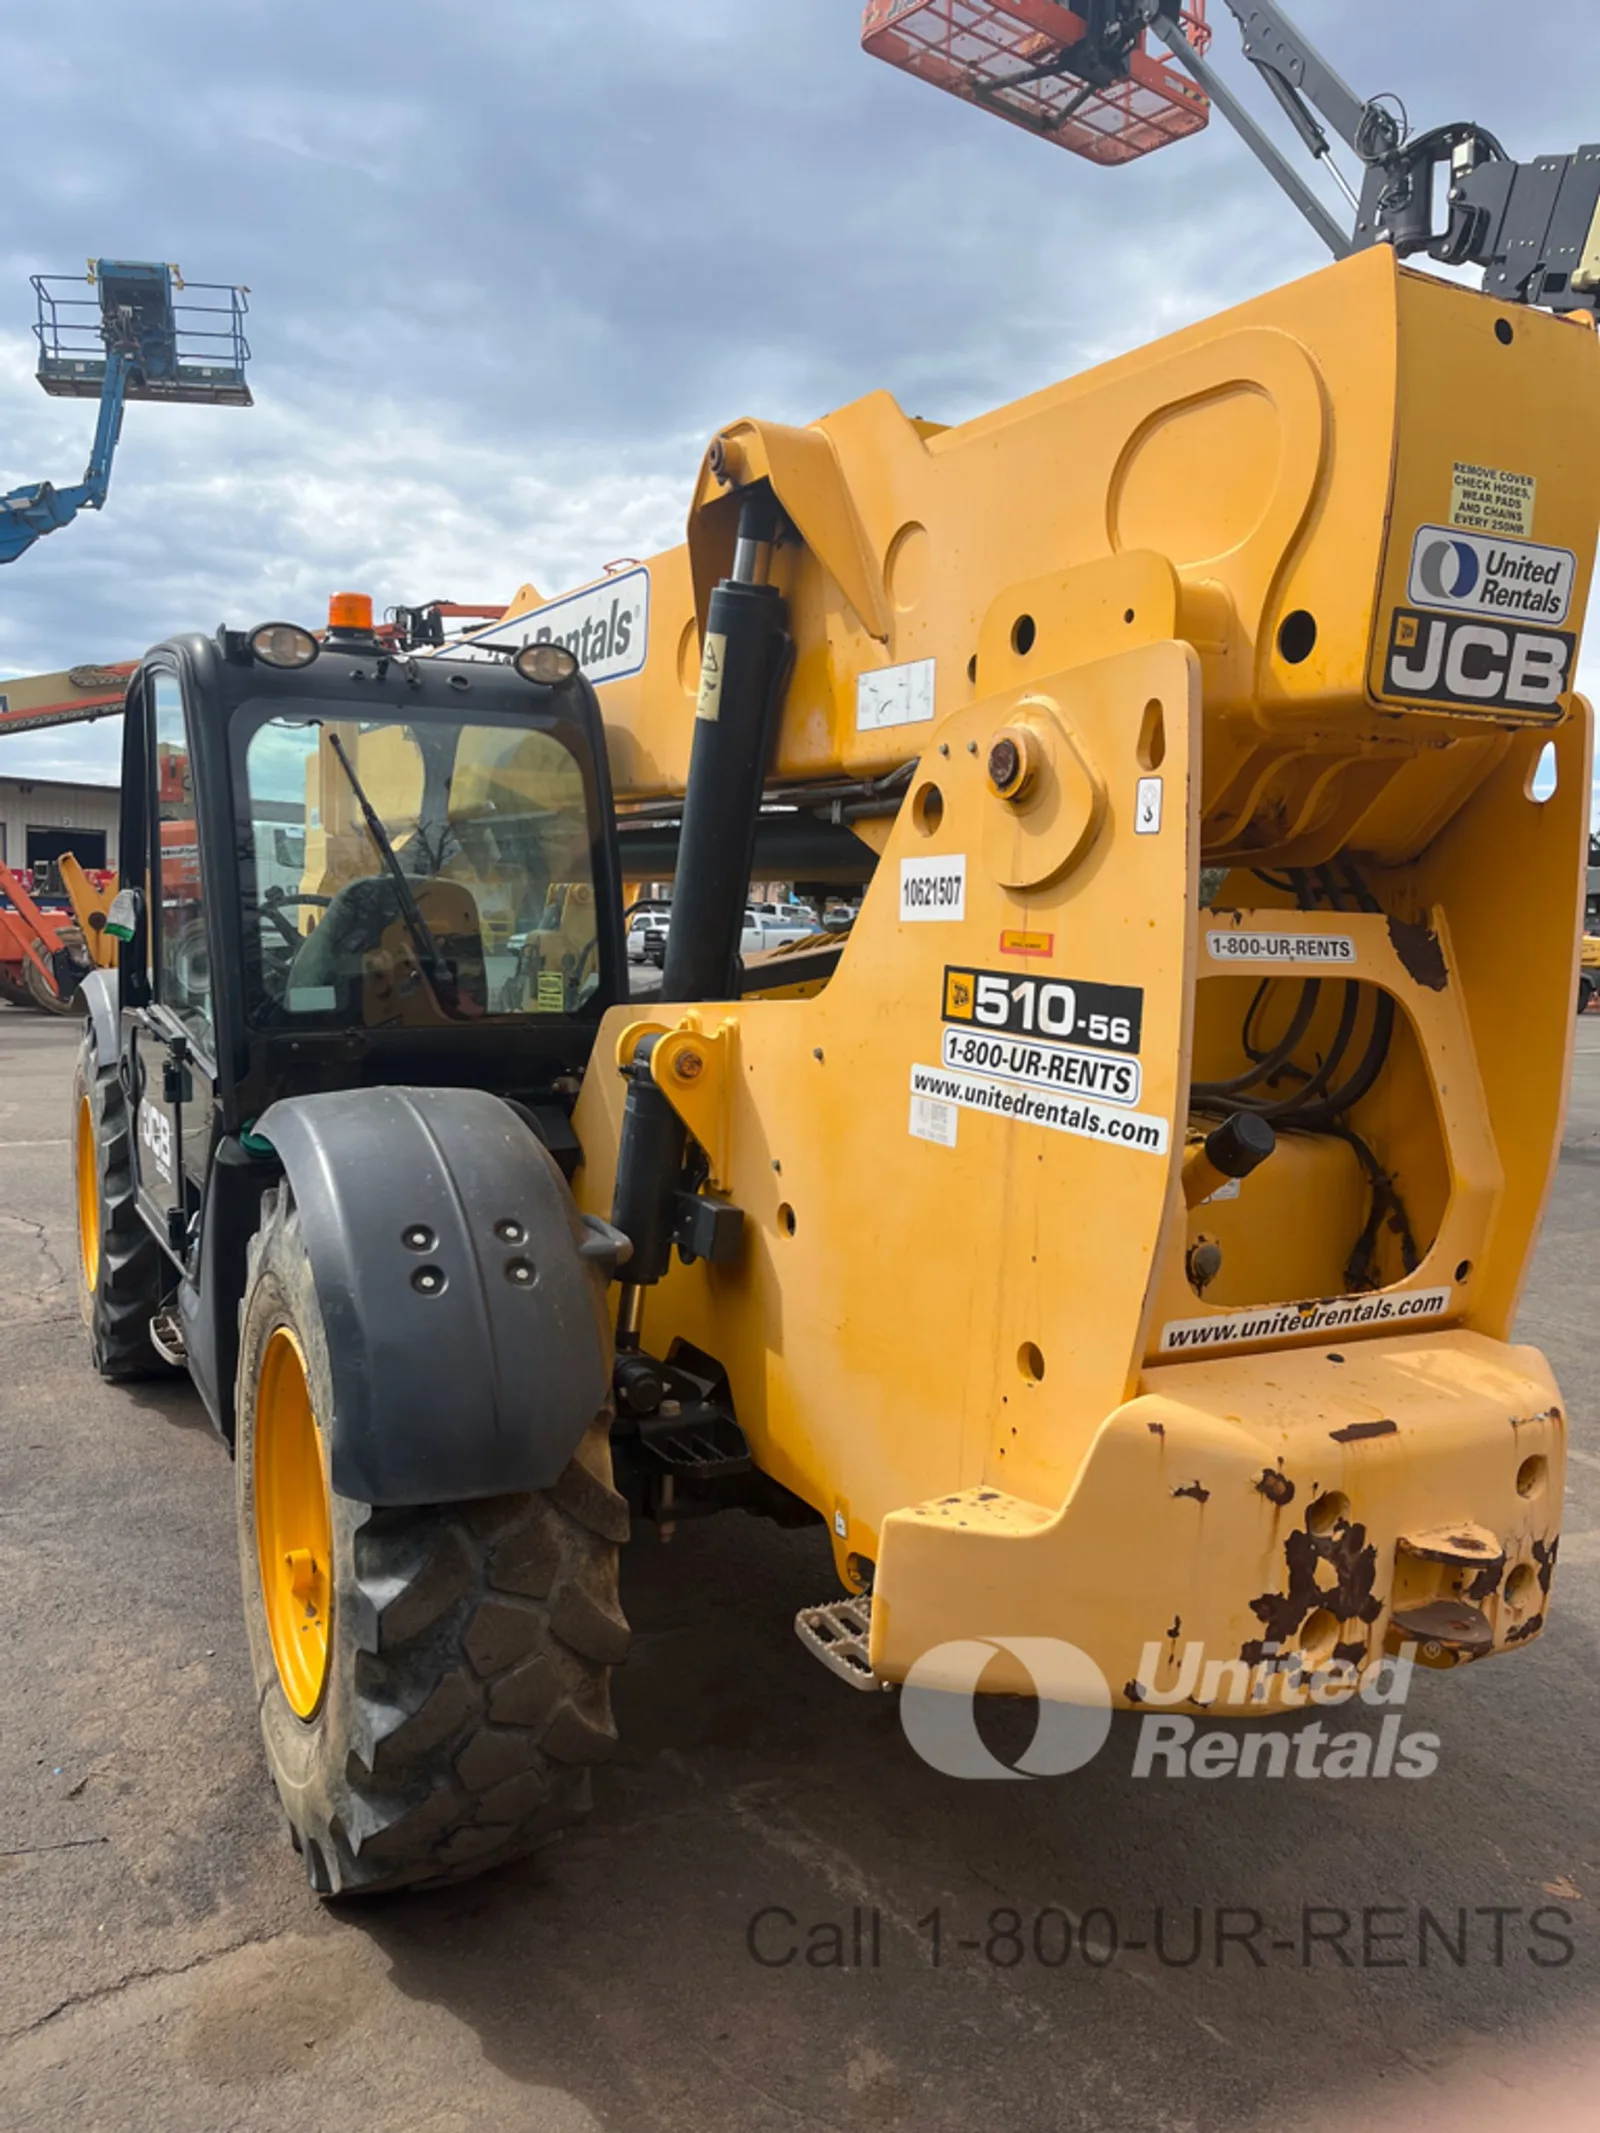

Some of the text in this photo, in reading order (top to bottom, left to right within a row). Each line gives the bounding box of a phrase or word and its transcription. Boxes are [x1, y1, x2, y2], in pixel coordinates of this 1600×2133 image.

[1454, 462, 1533, 486] REMOVE COVER
[1454, 475, 1530, 500] CHECK HOSES,
[1458, 502, 1521, 521] AND CHAINS
[1463, 489, 1521, 509] WEAR PADS
[1454, 513, 1488, 527] EVERY
[1486, 550, 1561, 585] United
[1479, 579, 1561, 614] Rentals
[1390, 620, 1568, 704] JCB
[903, 876, 962, 906] 10621507
[1212, 938, 1350, 957] 1-800-UR-RENTS
[948, 1037, 1132, 1094] 1-800-UR-RENTS
[914, 1073, 1160, 1147] www.unitedrentals.com
[1168, 1295, 1444, 1348] www.unitedrentals.com
